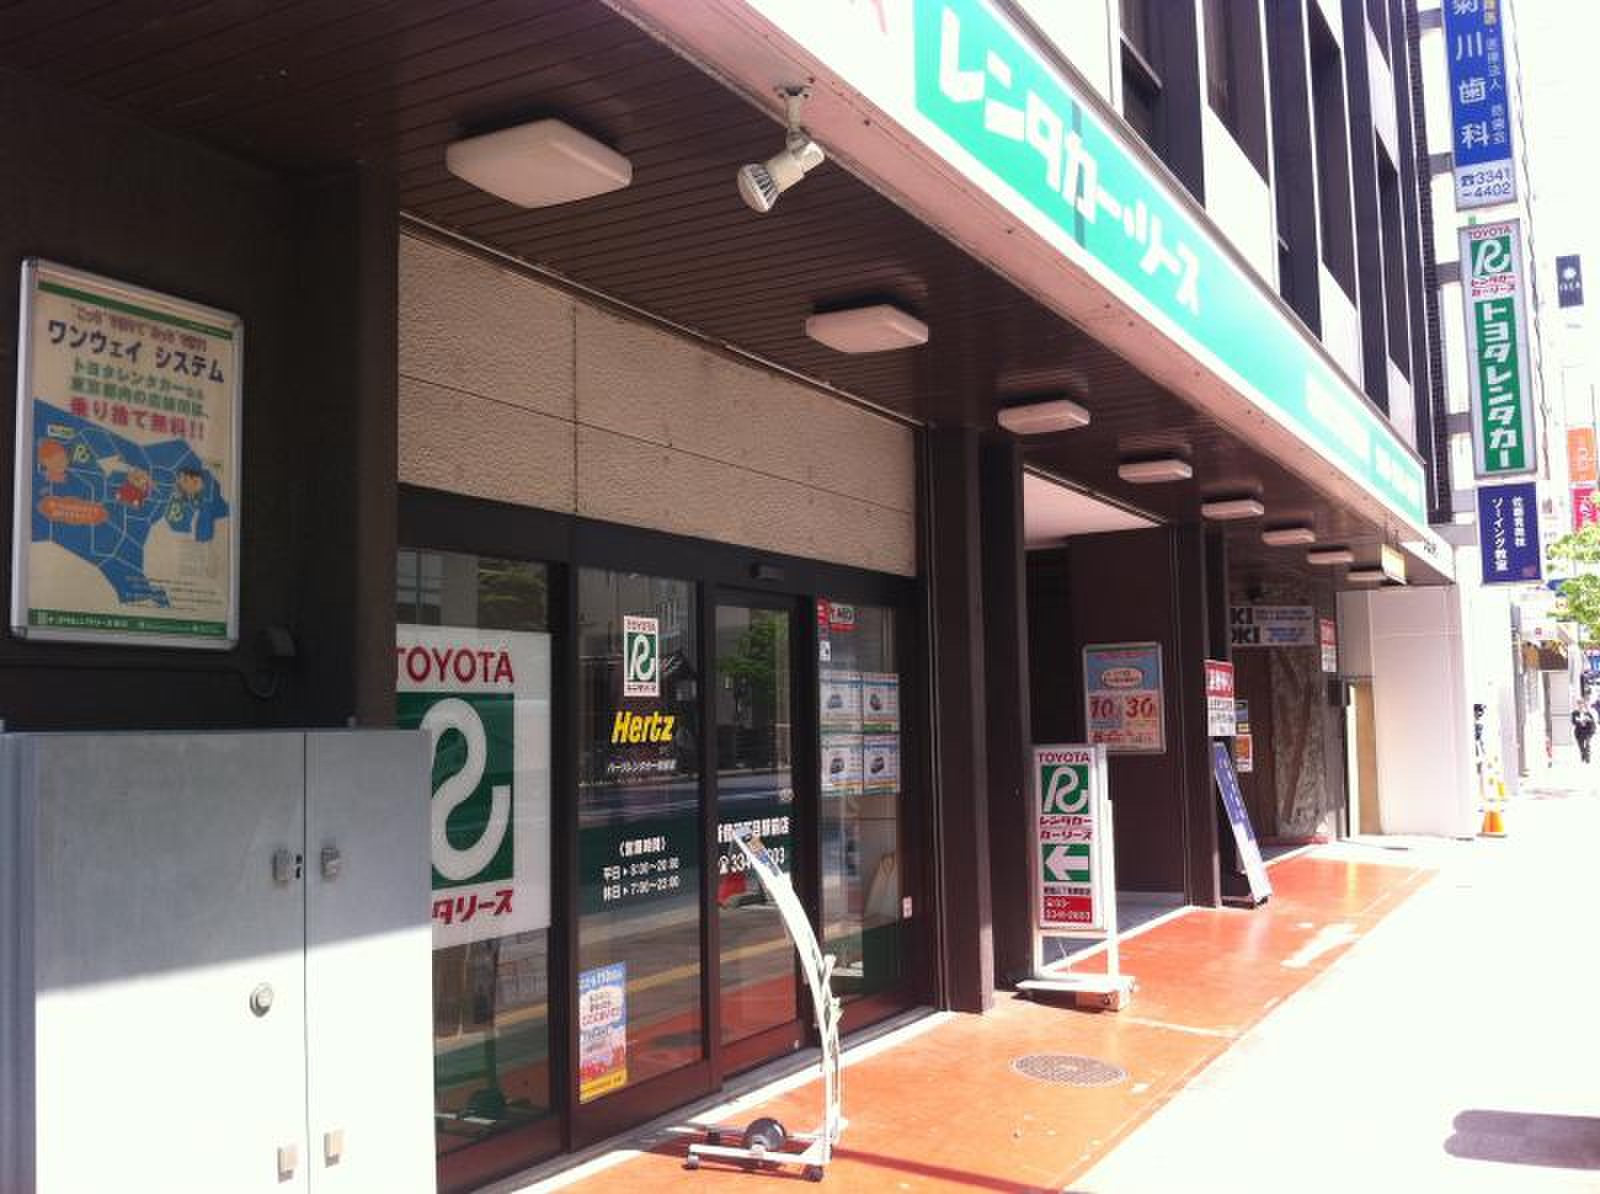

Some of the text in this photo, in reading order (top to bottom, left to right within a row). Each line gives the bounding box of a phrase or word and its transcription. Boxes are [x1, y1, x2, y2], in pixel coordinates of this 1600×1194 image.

[1469, 225, 1513, 239] TOYOTA
[48, 319, 142, 364] ワンウェイ
[156, 346, 225, 385] システム
[1484, 302, 1516, 467] トヨタレンタカー
[1491, 496, 1509, 572] ソーイング教室
[611, 711, 674, 744] Hertz
[1039, 751, 1091, 763] TOYOTA
[1039, 815, 1092, 826] レンタカー
[1039, 830, 1093, 841] カーリース
